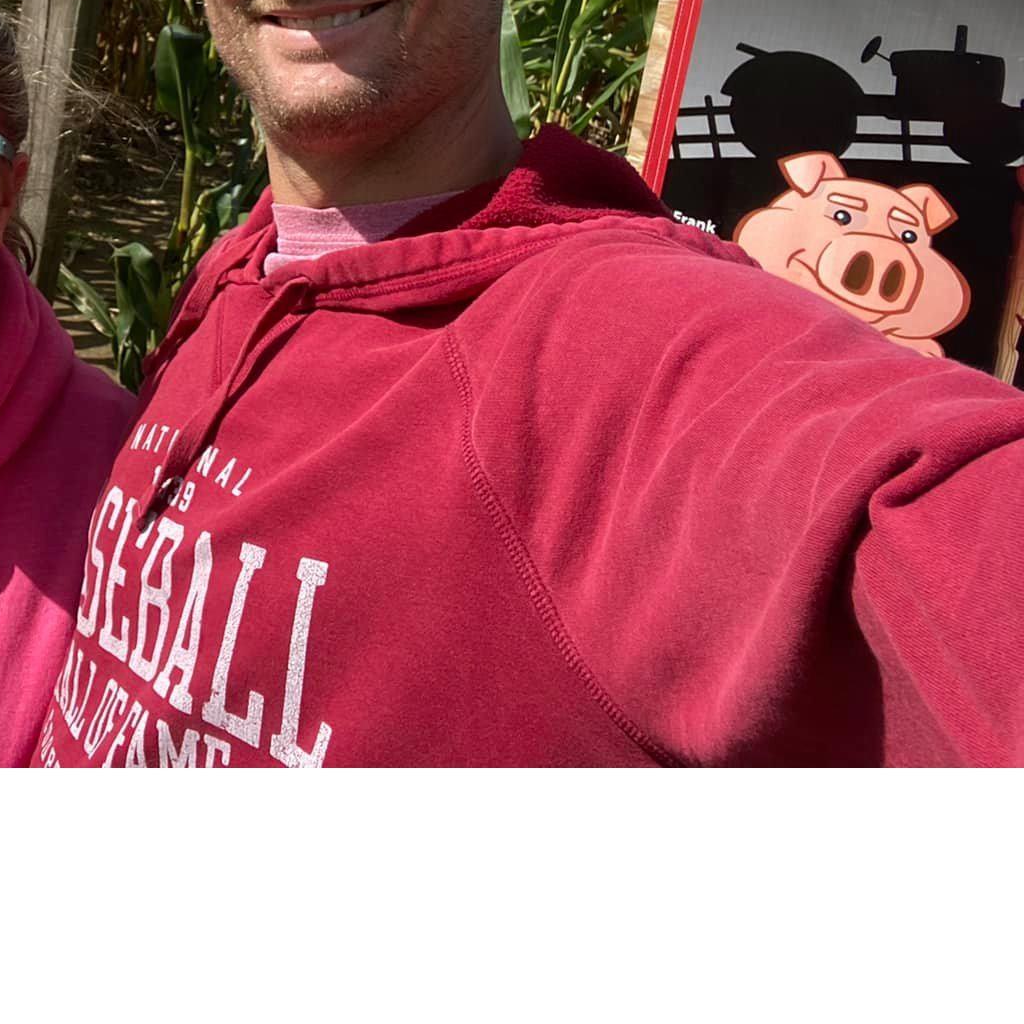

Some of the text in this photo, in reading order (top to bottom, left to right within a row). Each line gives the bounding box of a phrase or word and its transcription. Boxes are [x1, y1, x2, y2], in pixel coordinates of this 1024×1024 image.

[673, 210, 716, 234] Frank
[130, 423, 252, 496] NATINAL
[152, 465, 196, 512] 19
